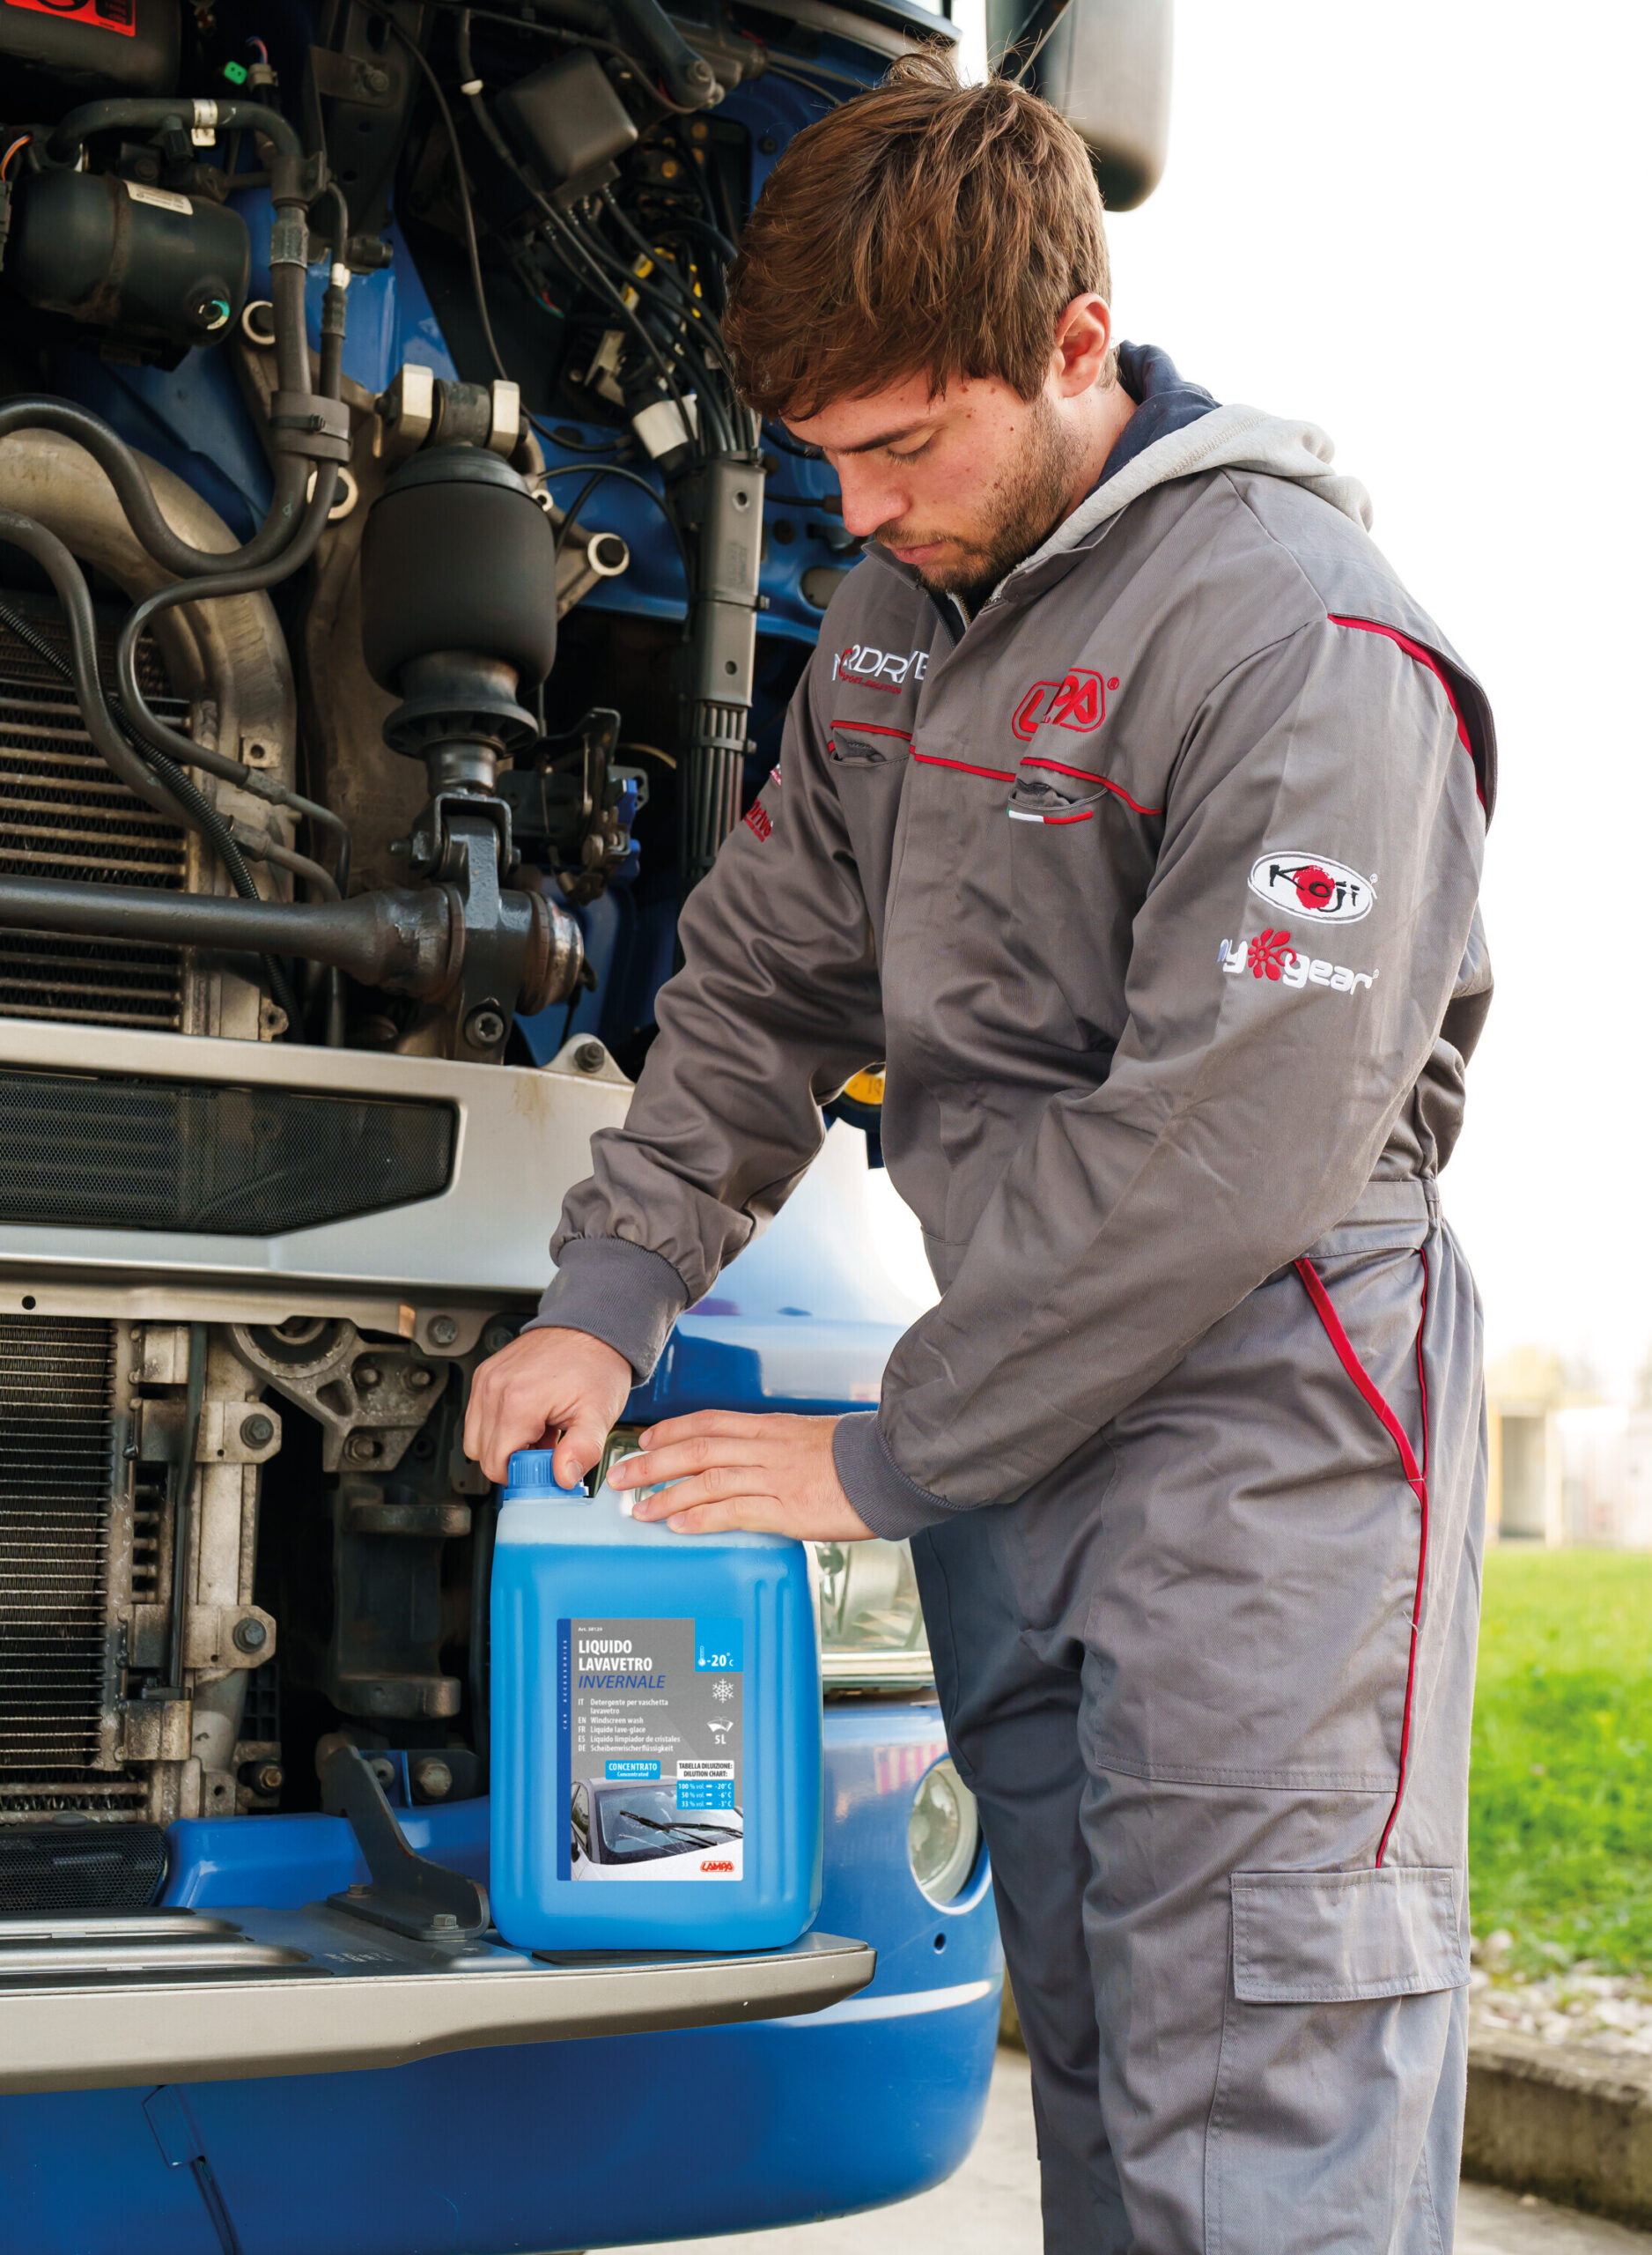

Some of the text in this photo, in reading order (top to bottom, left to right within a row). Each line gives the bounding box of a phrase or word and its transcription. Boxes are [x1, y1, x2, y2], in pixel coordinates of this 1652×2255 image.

[578, 1639, 632, 1655] LIQUIDO
[578, 1657, 653, 1671] LAVAVETRO
[578, 1675, 666, 1689] INVERNALE
[590, 1698, 626, 1707] Detergente
[615, 1735, 645, 1744] limpiador
